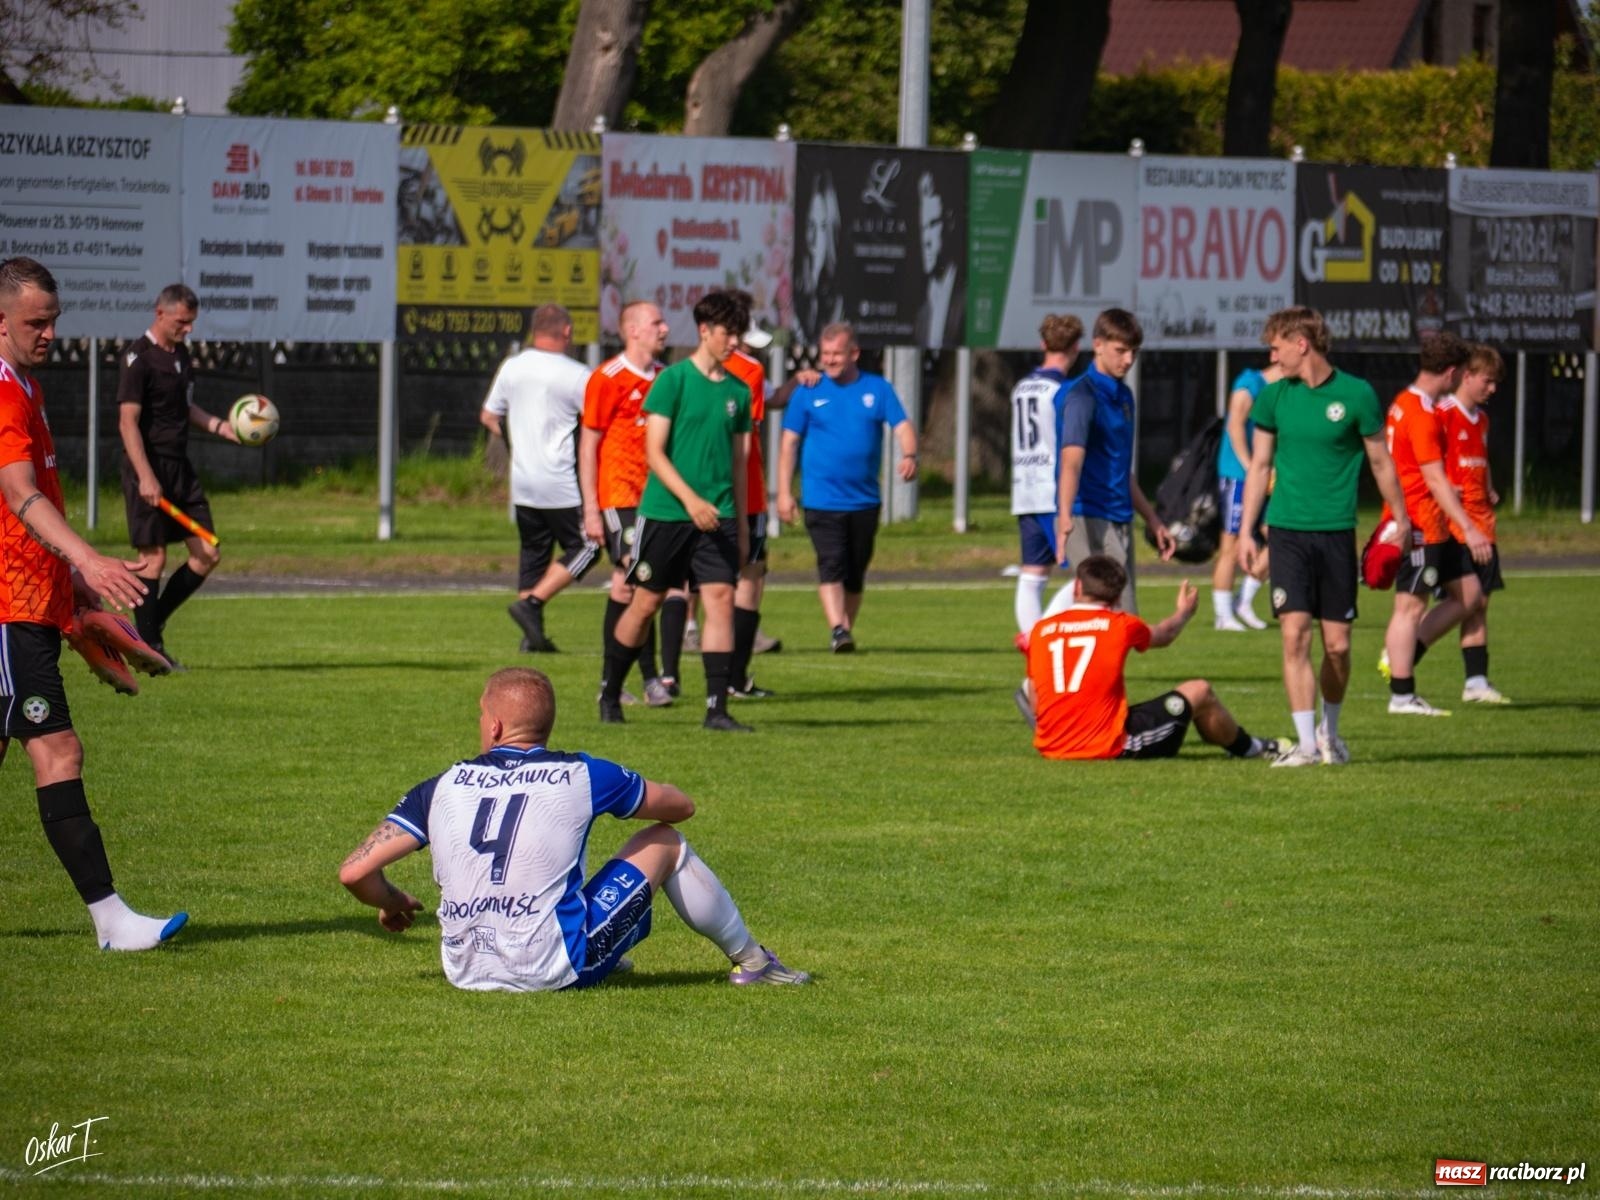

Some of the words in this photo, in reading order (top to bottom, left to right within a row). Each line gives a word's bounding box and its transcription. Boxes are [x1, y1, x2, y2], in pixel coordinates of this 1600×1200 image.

[67, 135, 151, 160] KRZYSZTOF
[212, 181, 271, 200] DAW-BUD
[702, 164, 787, 203] KRYSTYNA
[1140, 204, 1287, 284] BRAVO
[1412, 261, 1432, 284] DO
[1433, 261, 1442, 285] Z
[1016, 397, 1040, 451] 15
[1048, 635, 1097, 693] 17
[469, 792, 529, 886] 4
